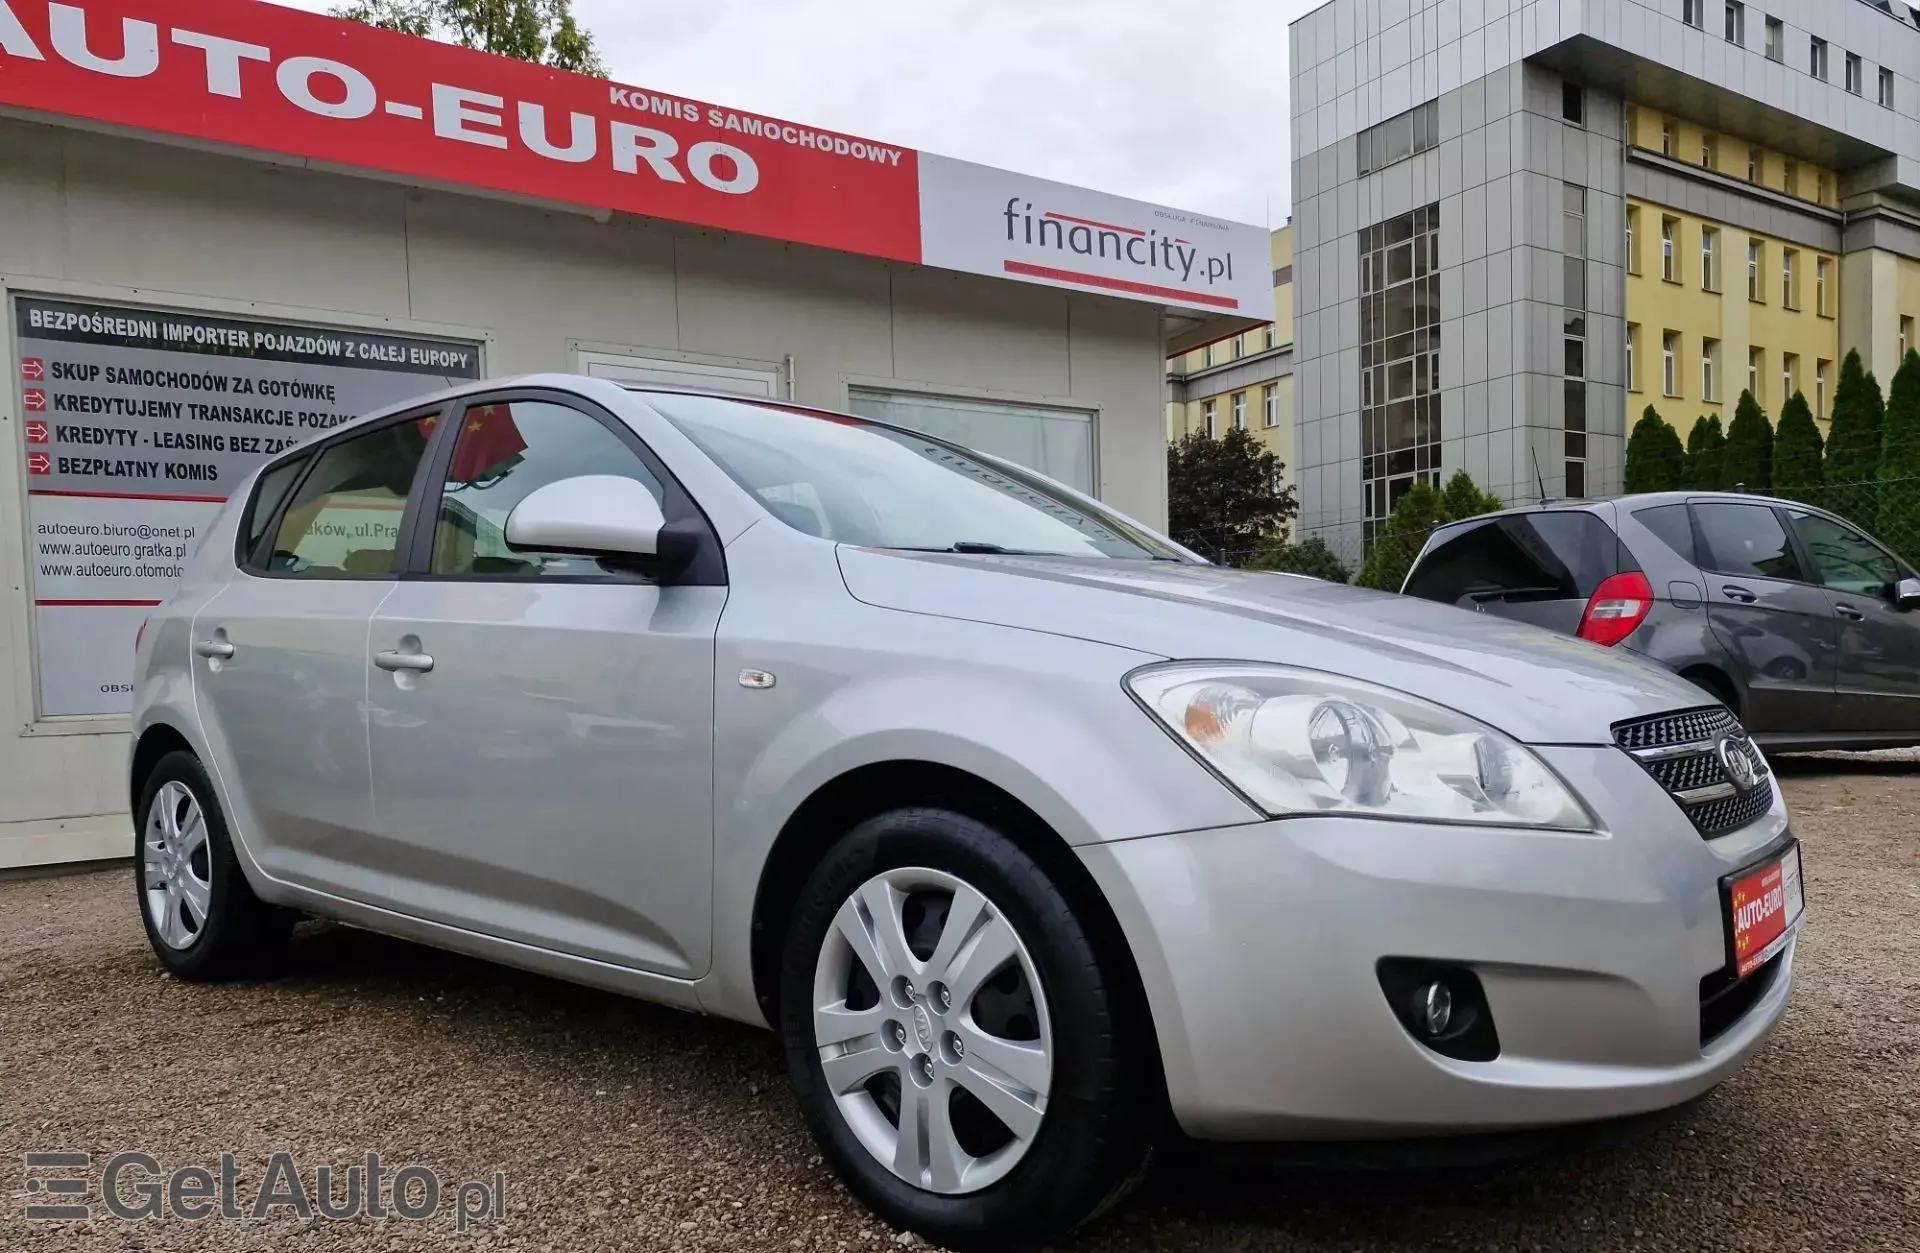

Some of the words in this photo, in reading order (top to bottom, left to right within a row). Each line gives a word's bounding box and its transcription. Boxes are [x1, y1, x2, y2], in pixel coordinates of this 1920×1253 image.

[609, 86, 700, 122] KOMIS
[708, 108, 901, 167] SAMOCHODOWY
[1003, 197, 1233, 285] financity.pl
[30, 309, 157, 339] BEZPOŚREDNI
[162, 322, 250, 349] IMPORTER
[254, 335, 341, 357] POJAZDÓW
[345, 341, 356, 358] Z
[359, 343, 406, 363] CAŁEJ
[411, 347, 468, 369] EUROPY
[51, 361, 100, 382] SKUP
[105, 366, 228, 393] SAMOCHODÓW
[232, 377, 254, 394] ZA
[259, 378, 336, 405] GOTÓWKĘ
[53, 393, 182, 419] KREDYTUJEMY
[188, 403, 294, 426] TRANSAKCJE
[56, 425, 138, 447] KREDYTY
[153, 431, 225, 451] LEASING
[229, 436, 261, 454] BEZ
[58, 457, 159, 479] BEZPŁATNY
[165, 462, 218, 481] KOMIS
[38, 523, 195, 540] autoeuro.biuro@onet.pl
[39, 542, 186, 561] www.autoeuro.gratka.pl
[1737, 884, 1783, 933] AUTO-EURO
